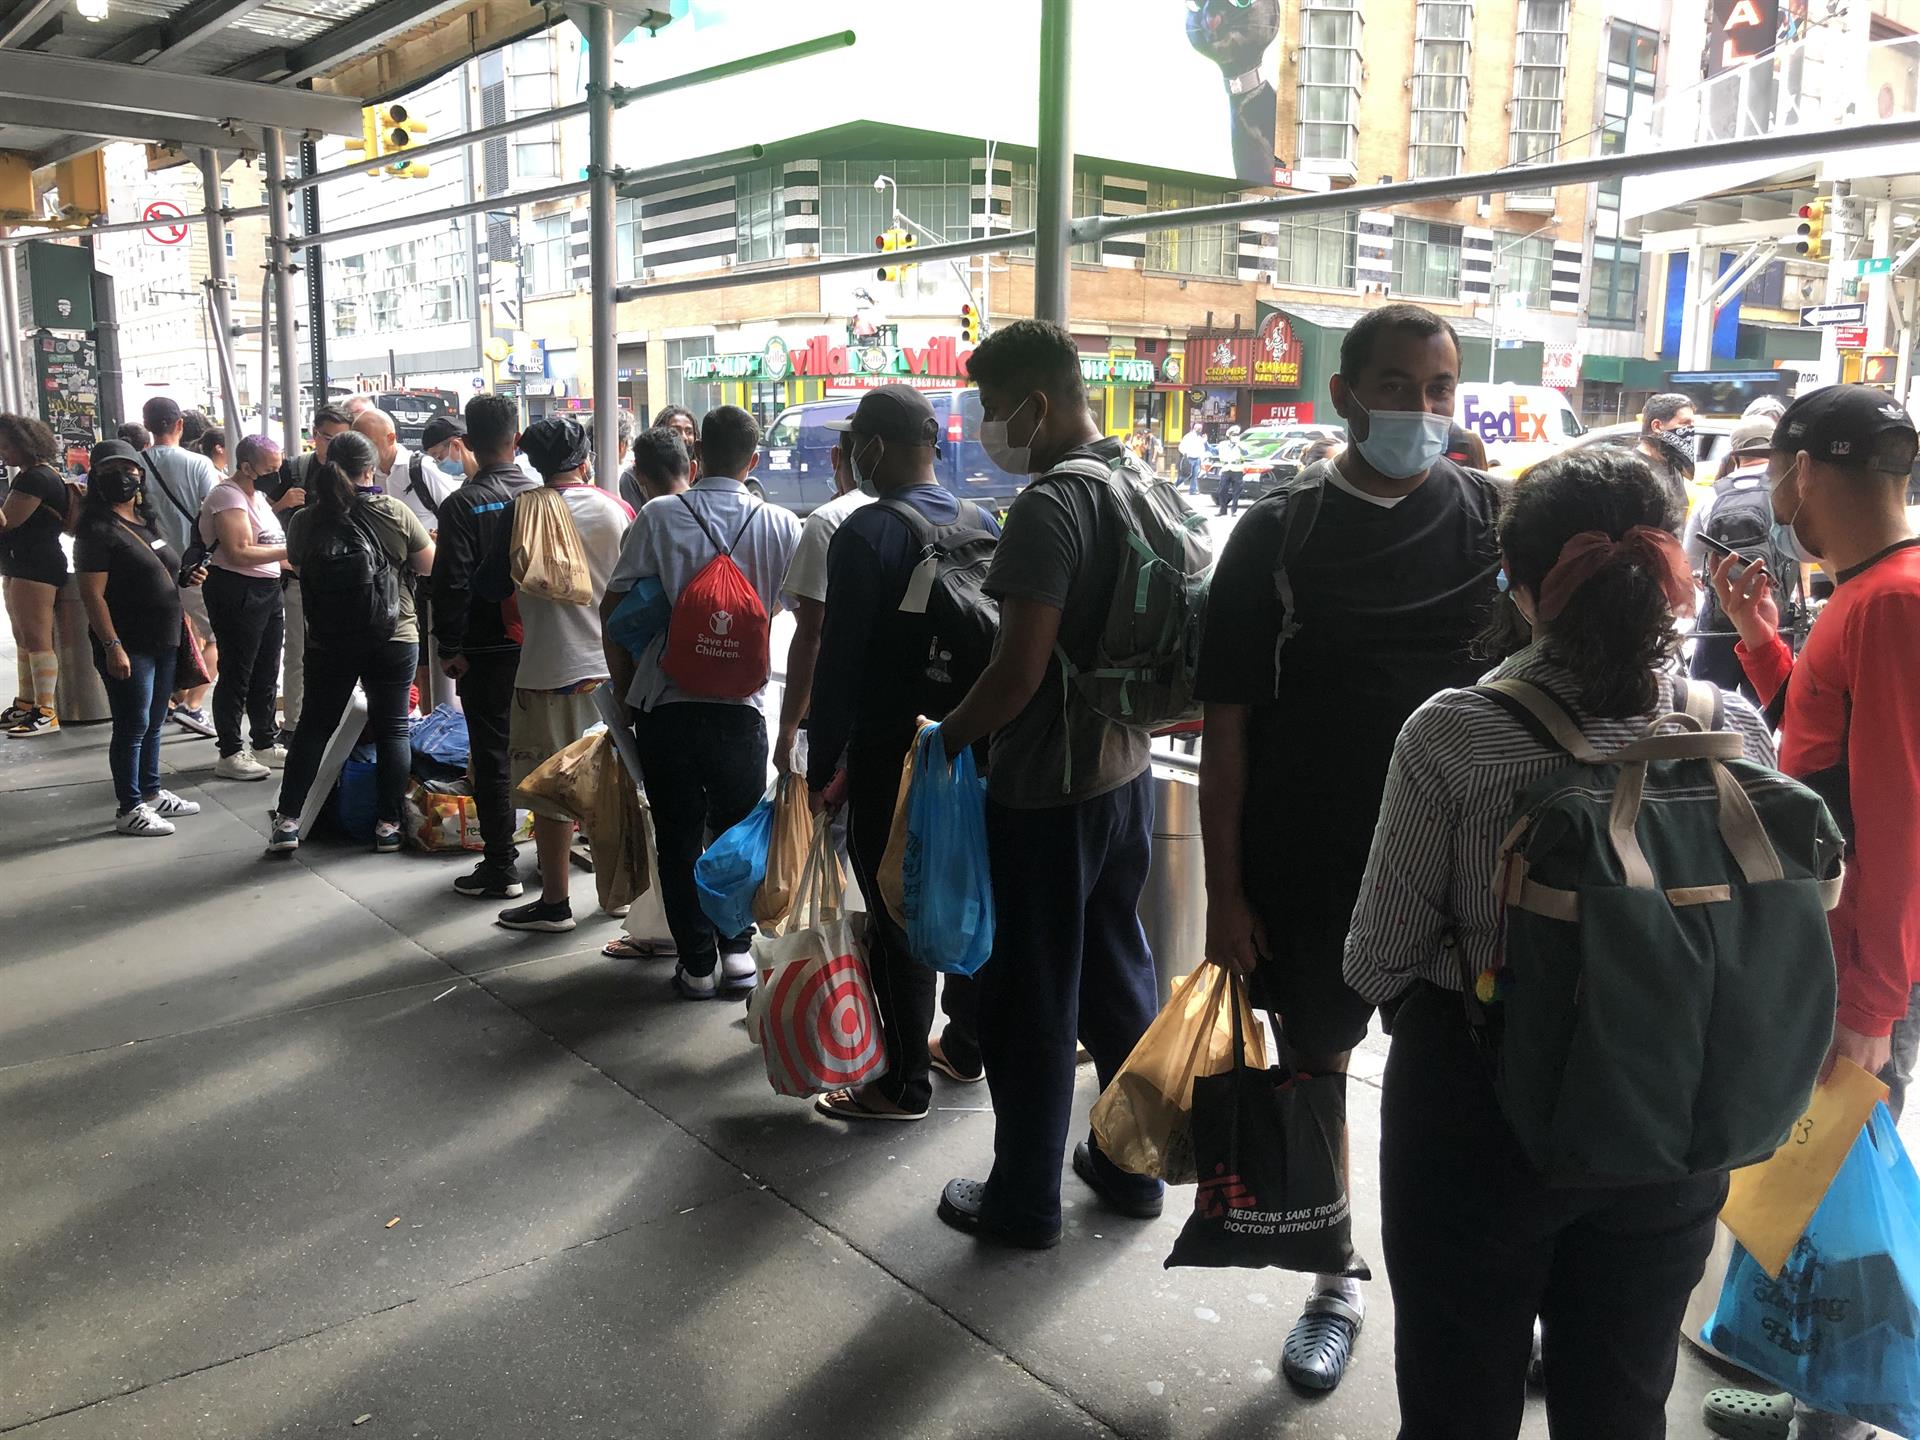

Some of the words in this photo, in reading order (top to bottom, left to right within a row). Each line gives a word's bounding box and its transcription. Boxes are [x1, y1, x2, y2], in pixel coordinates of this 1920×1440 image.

[789, 335, 847, 376] villa
[1122, 362, 1154, 382] PASTA
[1205, 367, 1247, 376] CRUMBS
[1255, 360, 1298, 374] CRUMBS
[833, 377, 856, 386] PIZZA
[1270, 406, 1296, 417] FIVE
[1463, 395, 1550, 444] FedEx
[697, 633, 722, 647] Save
[723, 639, 740, 648] the
[1228, 1208, 1283, 1222] MEDECINS
[1285, 1208, 1311, 1220] SANS
[1223, 1220, 1276, 1235] DOCTORS
[1279, 1219, 1327, 1233] WITHOUT
